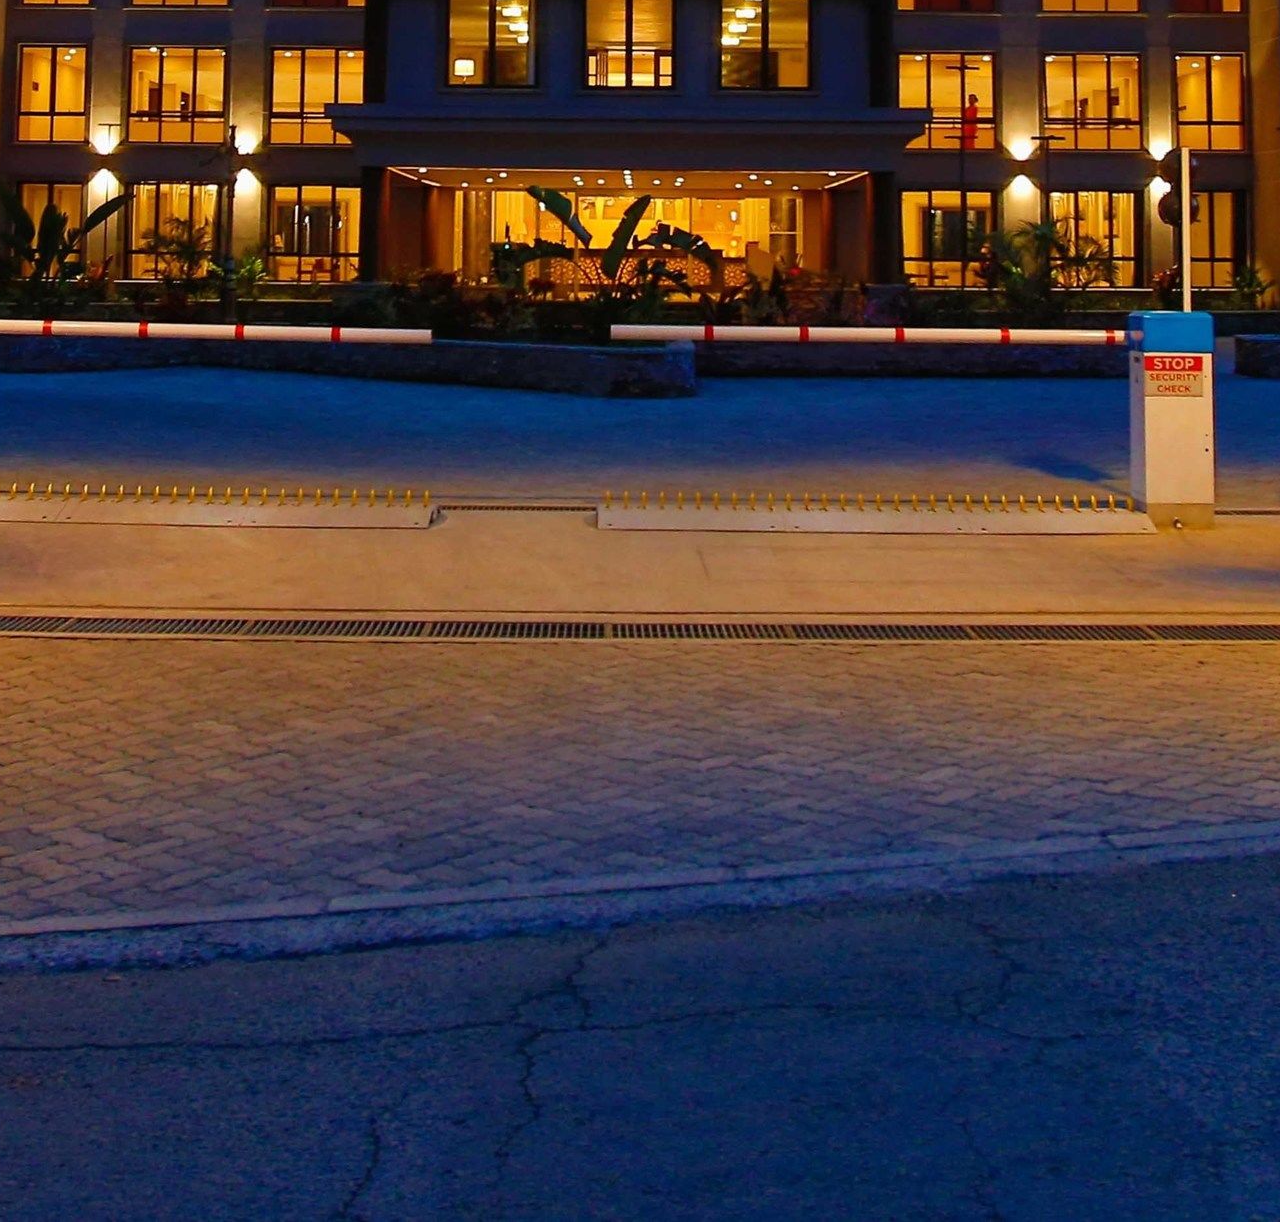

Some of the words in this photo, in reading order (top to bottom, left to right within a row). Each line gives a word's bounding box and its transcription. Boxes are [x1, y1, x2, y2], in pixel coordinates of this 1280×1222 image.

[1153, 358, 1195, 370] STOP
[1150, 373, 1198, 381] SECURITY
[1157, 384, 1191, 393] CHECK
